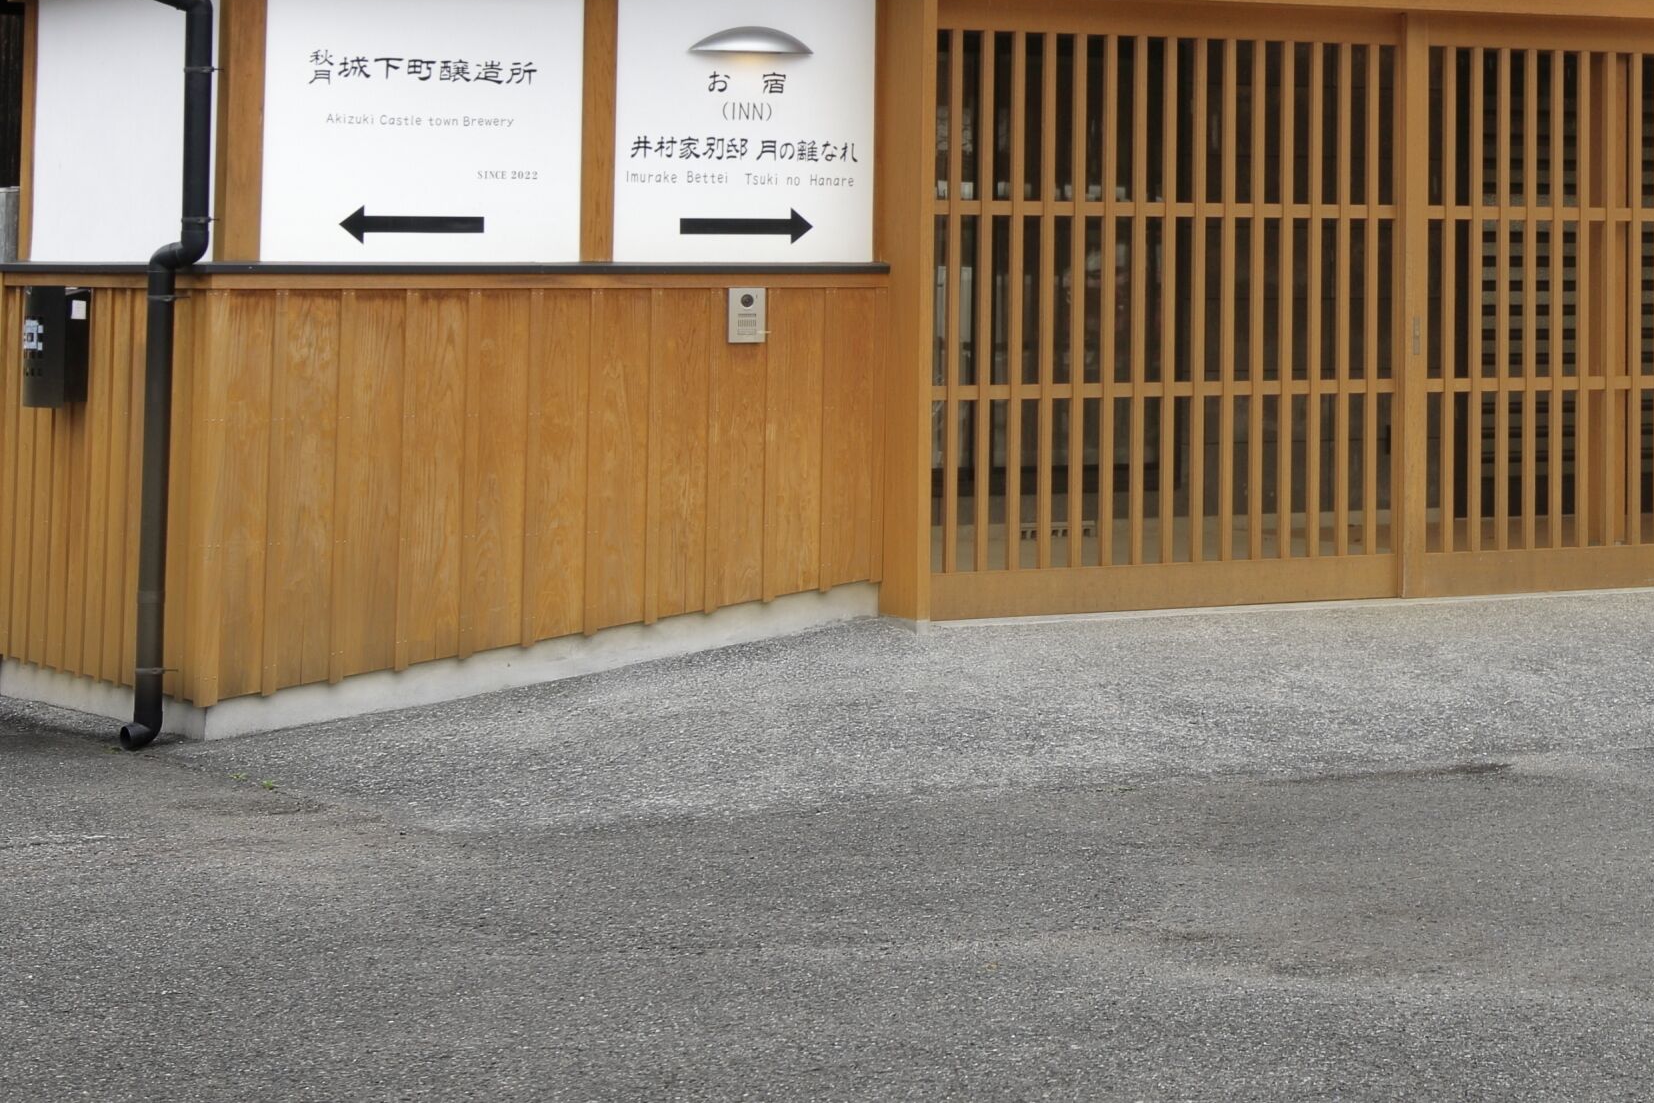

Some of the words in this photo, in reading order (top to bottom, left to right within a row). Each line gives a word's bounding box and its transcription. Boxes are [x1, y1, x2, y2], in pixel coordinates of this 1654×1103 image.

[326, 113, 374, 126] Akizuki
[379, 114, 422, 127] Castle
[427, 115, 459, 127] town
[463, 115, 514, 128] Brewery
[722, 101, 773, 122] (INN)
[630, 135, 748, 160] 井村家別邸
[756, 140, 859, 163] 月の離なれ
[477, 170, 507, 181] SINCE
[511, 170, 538, 181] 2022
[626, 170, 678, 184] Imurake
[686, 170, 728, 185] Bettei
[744, 172, 778, 186] Tsuki
[786, 175, 800, 186] no
[810, 173, 854, 188] Hanare
